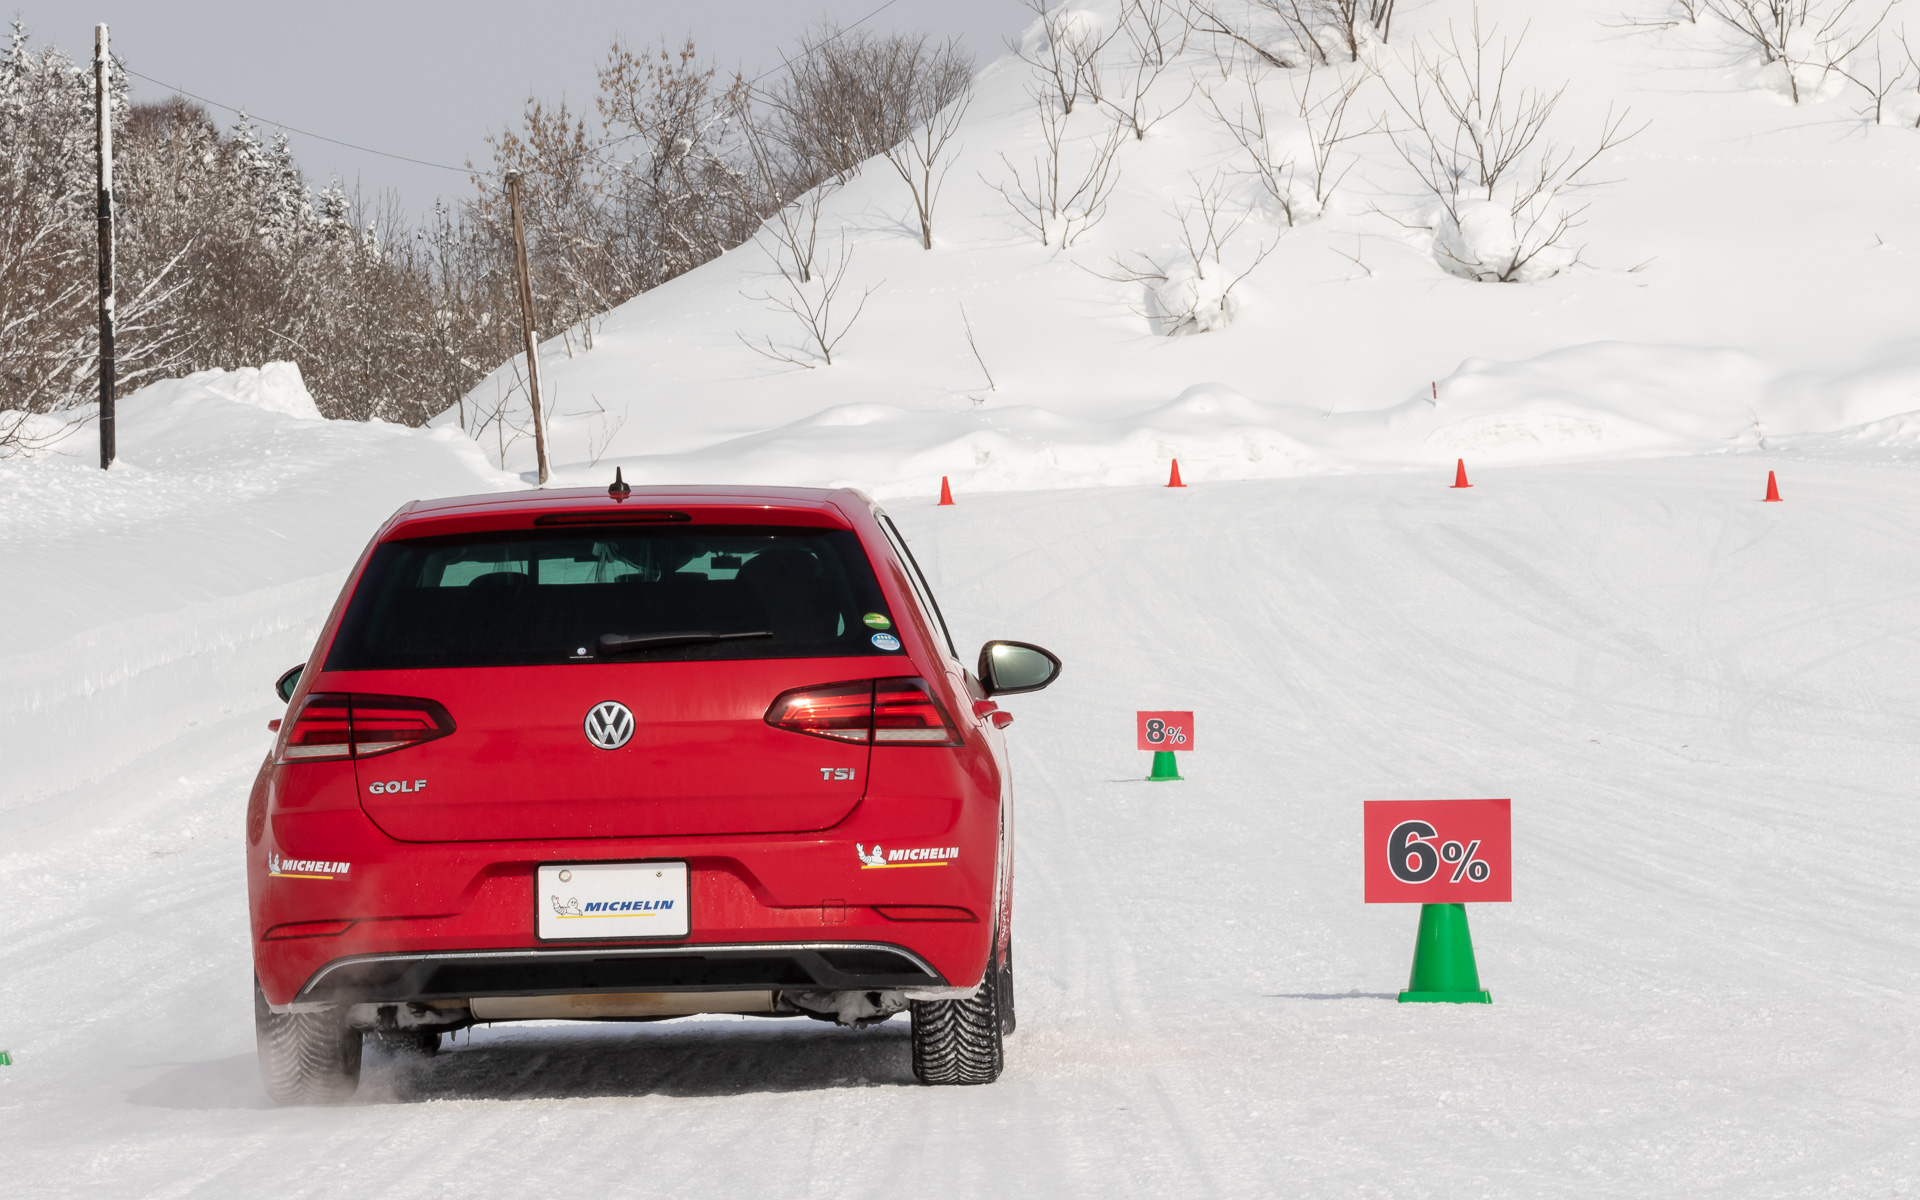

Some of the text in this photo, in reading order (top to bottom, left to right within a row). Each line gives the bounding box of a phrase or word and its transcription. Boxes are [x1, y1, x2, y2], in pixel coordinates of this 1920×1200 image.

[1145, 718, 1187, 744] 8%
[819, 767, 856, 781] TSI
[368, 779, 427, 794] GOLF
[888, 847, 960, 861] MICHELIN
[1387, 819, 1491, 884] 6%
[281, 859, 351, 874] MICHELIN
[584, 900, 674, 912] MICHELIN
